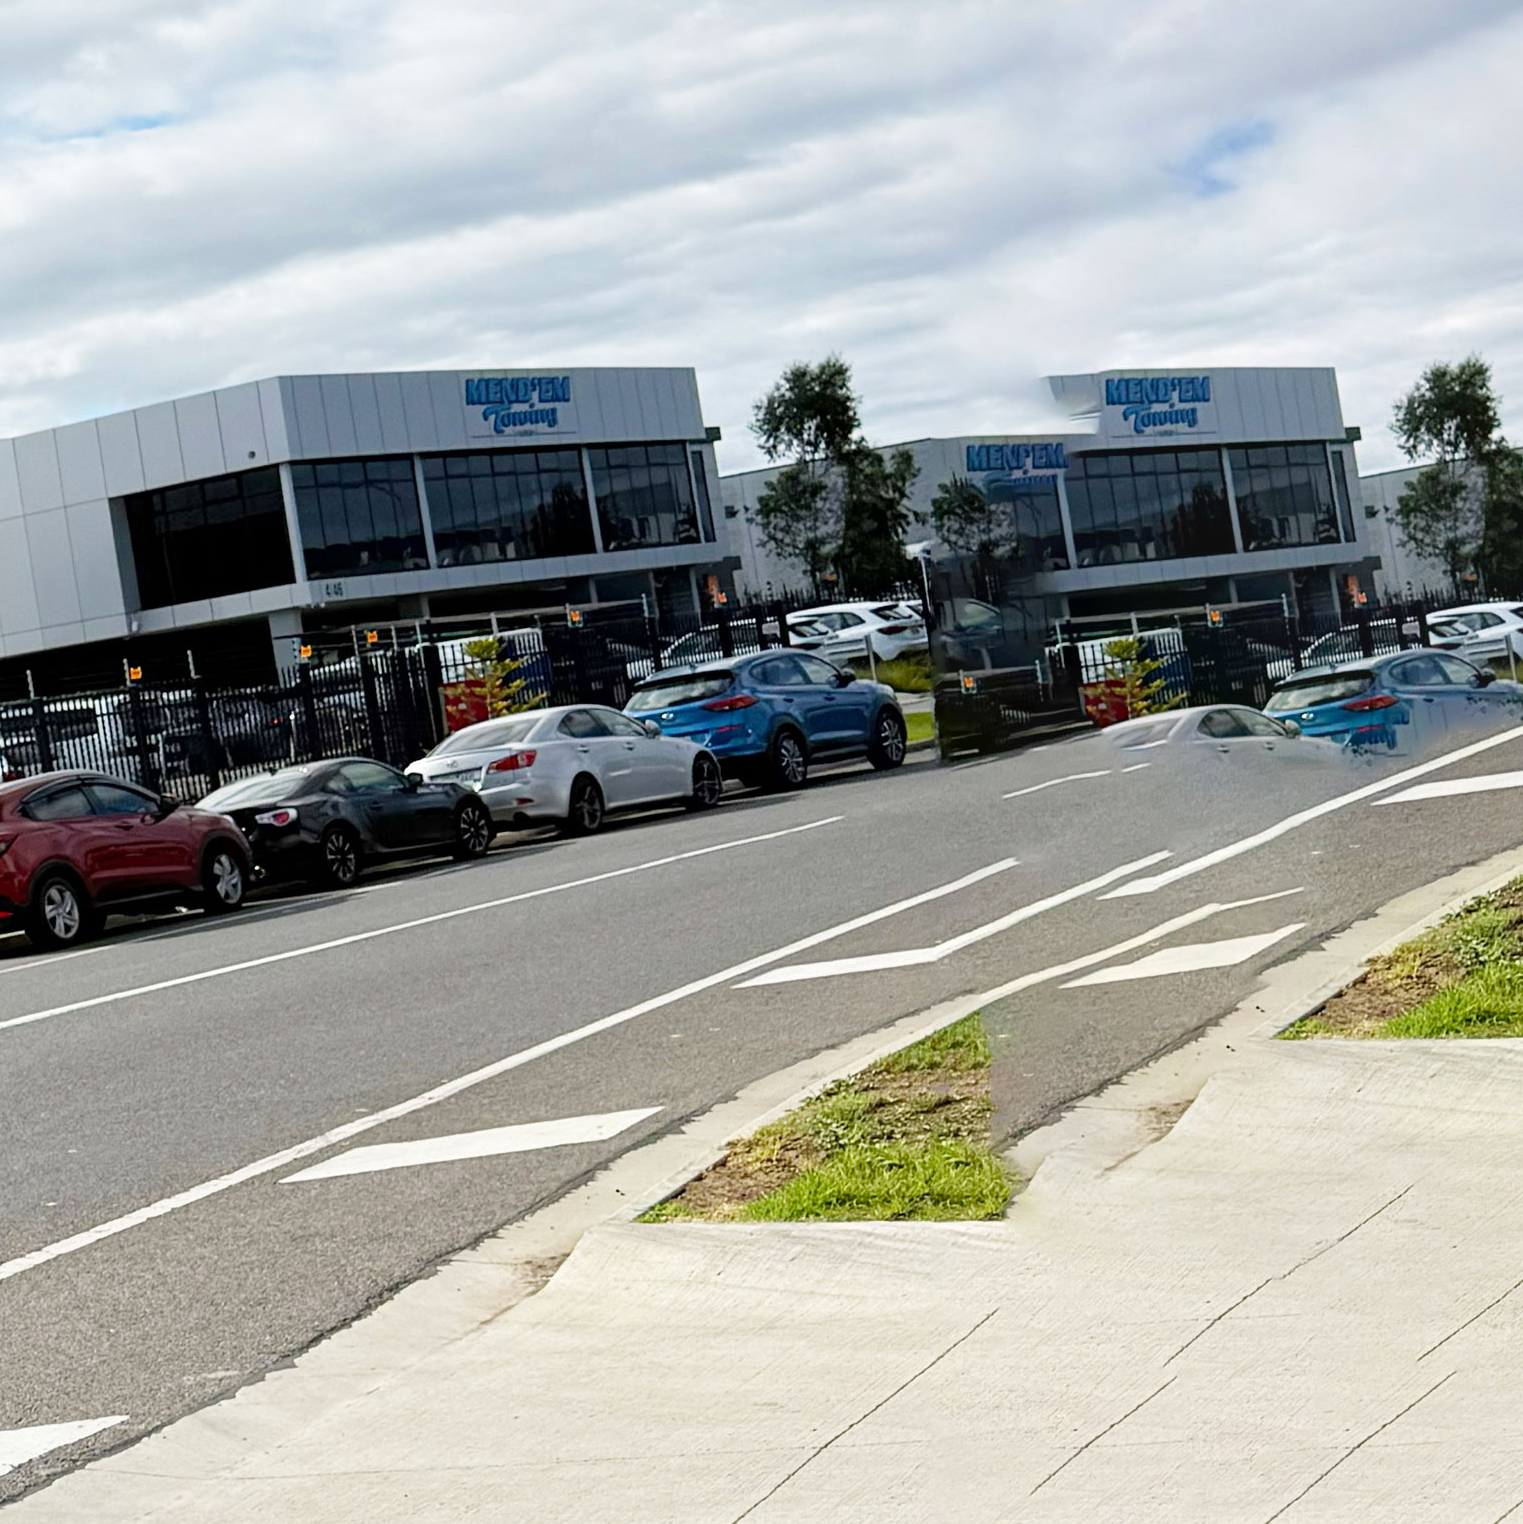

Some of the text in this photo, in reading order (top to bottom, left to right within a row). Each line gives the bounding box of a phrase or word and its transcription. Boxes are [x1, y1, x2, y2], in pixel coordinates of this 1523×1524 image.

[465, 376, 570, 405] MEND'EM
[1105, 376, 1210, 405] MEND'EM
[482, 403, 558, 434] Towing
[1122, 403, 1198, 434] Towing
